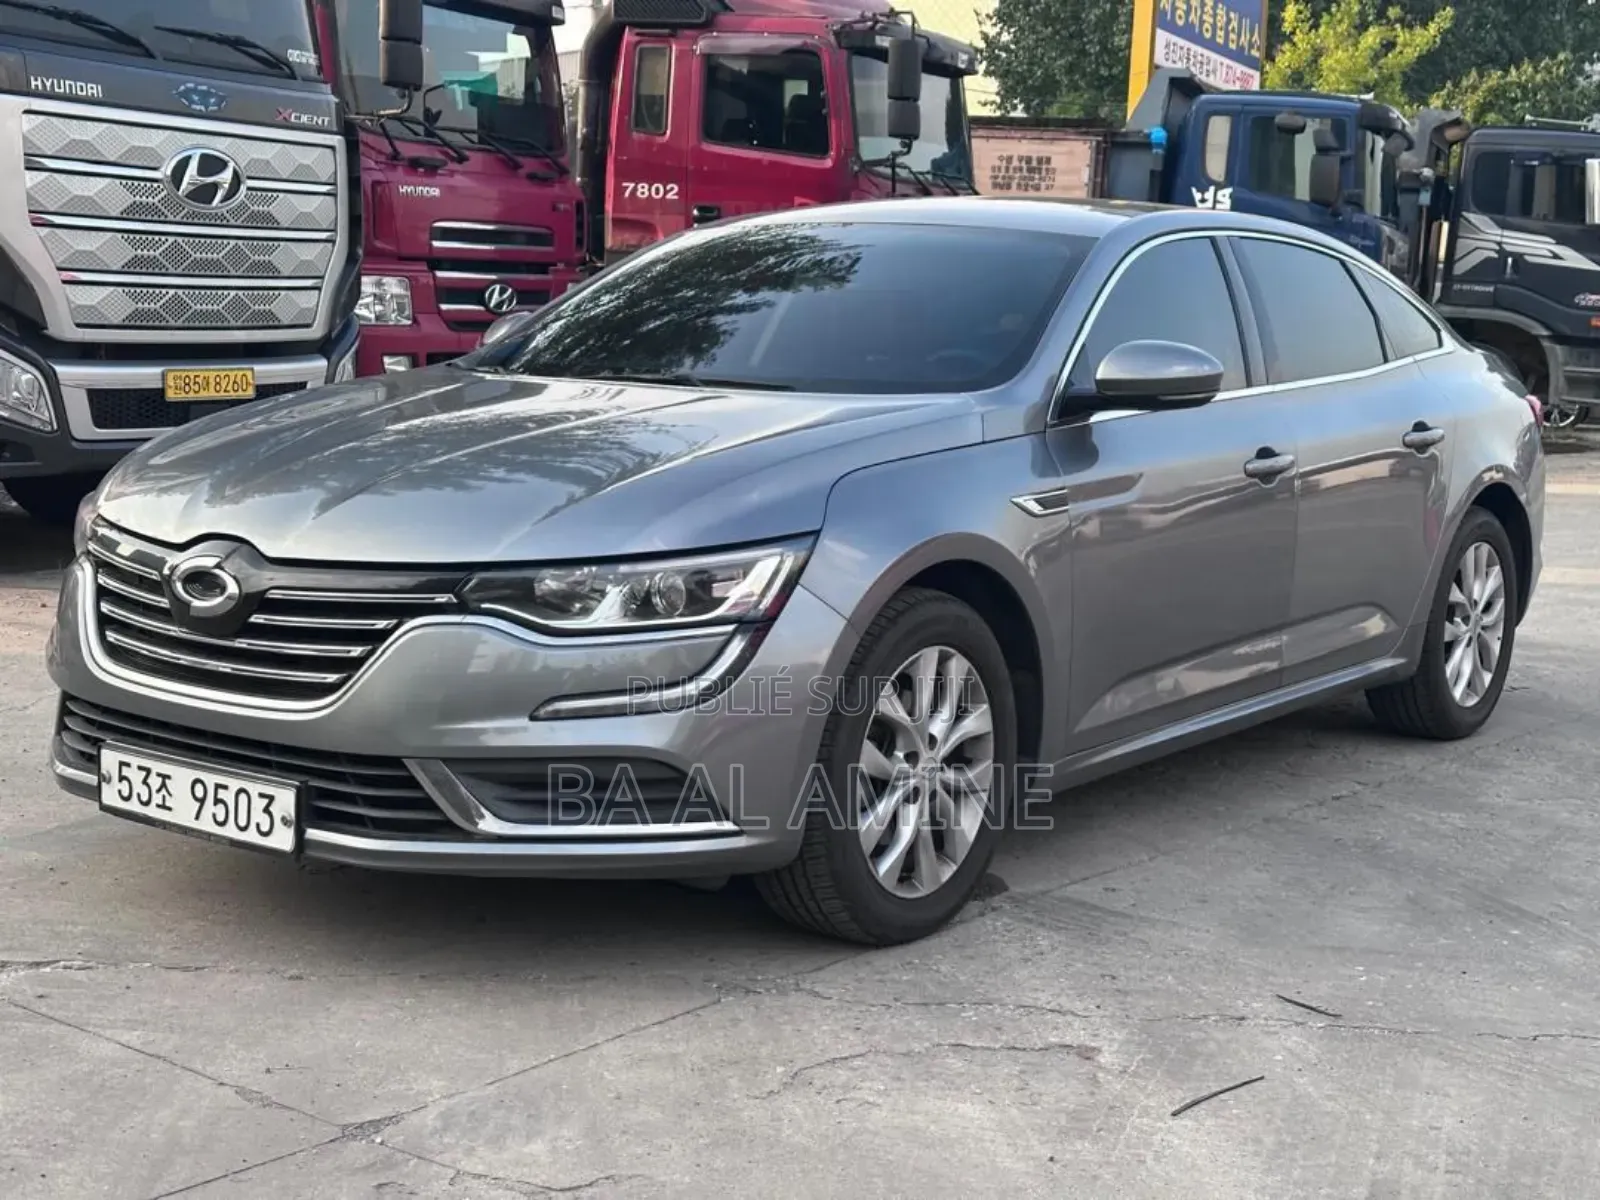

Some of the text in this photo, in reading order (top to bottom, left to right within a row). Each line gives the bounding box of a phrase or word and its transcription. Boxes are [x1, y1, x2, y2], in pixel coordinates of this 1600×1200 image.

[30, 75, 103, 98] HYUNDAI
[275, 107, 330, 127] XCIENT
[398, 184, 441, 198] HYUNDAI
[621, 182, 680, 200] 7802
[214, 373, 249, 393] 8260
[117, 760, 276, 838] 53조 9503
